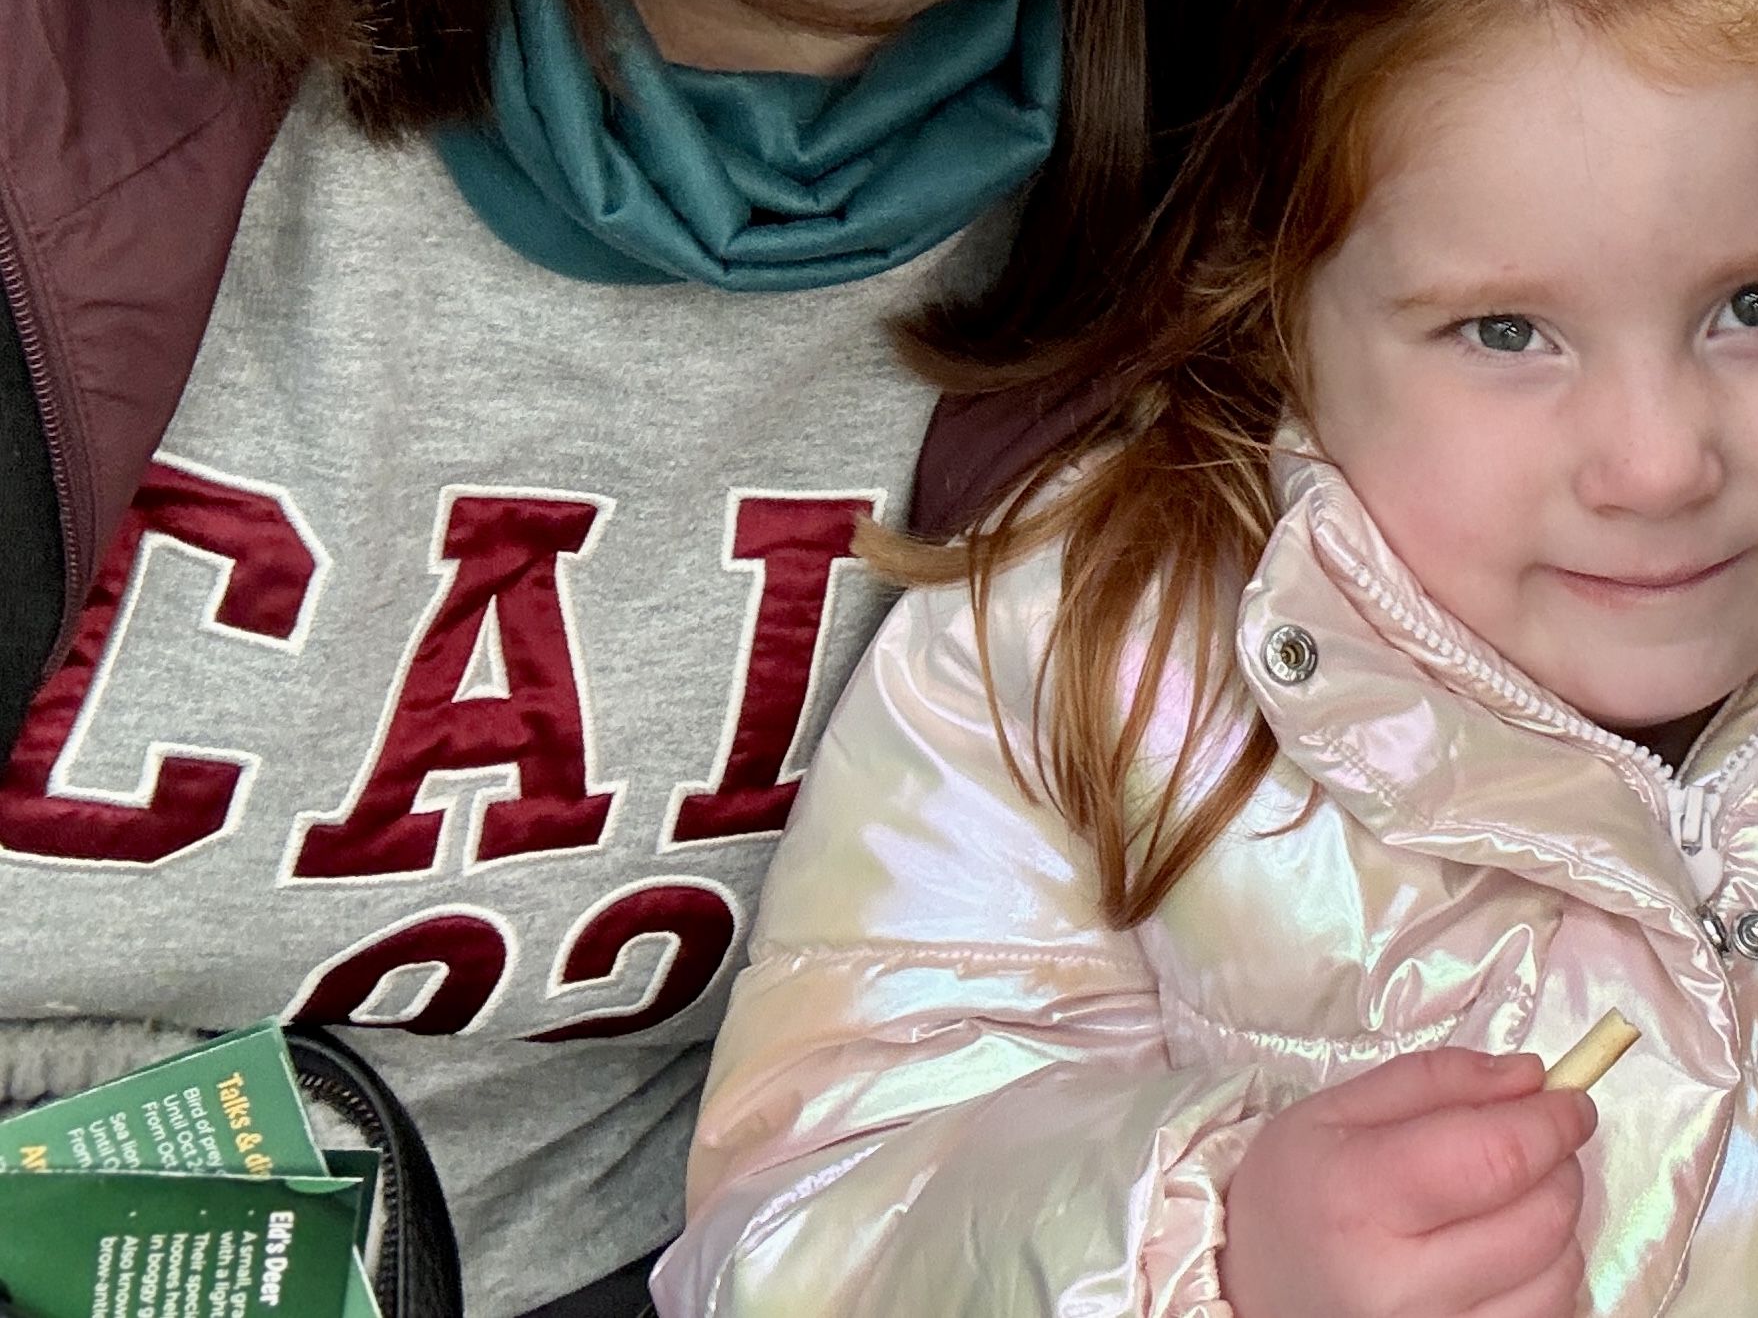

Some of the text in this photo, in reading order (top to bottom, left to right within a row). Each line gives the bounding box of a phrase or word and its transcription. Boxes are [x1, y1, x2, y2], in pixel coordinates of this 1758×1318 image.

[183, 1087, 208, 1119] Bird
[217, 1072, 250, 1130] Talks
[236, 1133, 262, 1153] &
[89, 1120, 116, 1157] Until
[110, 1112, 140, 1168] Sea lion
[141, 1101, 178, 1169] From Oct
[163, 1094, 189, 1130] Until
[177, 1131, 197, 1158] Oct
[195, 1120, 215, 1134] of
[67, 1127, 93, 1169] From
[198, 1136, 223, 1167] prey
[119, 1235, 139, 1269] Also
[150, 1234, 167, 1249] in
[190, 1232, 210, 1271] Their
[216, 1231, 234, 1266] with
[241, 1231, 258, 1243] A
[140, 1252, 165, 1304] boggy
[160, 1233, 189, 1318] hooves hel
[215, 1269, 230, 1279] a
[233, 1245, 254, 1290] small,
[259, 1210, 295, 1307] Eld's Deer
